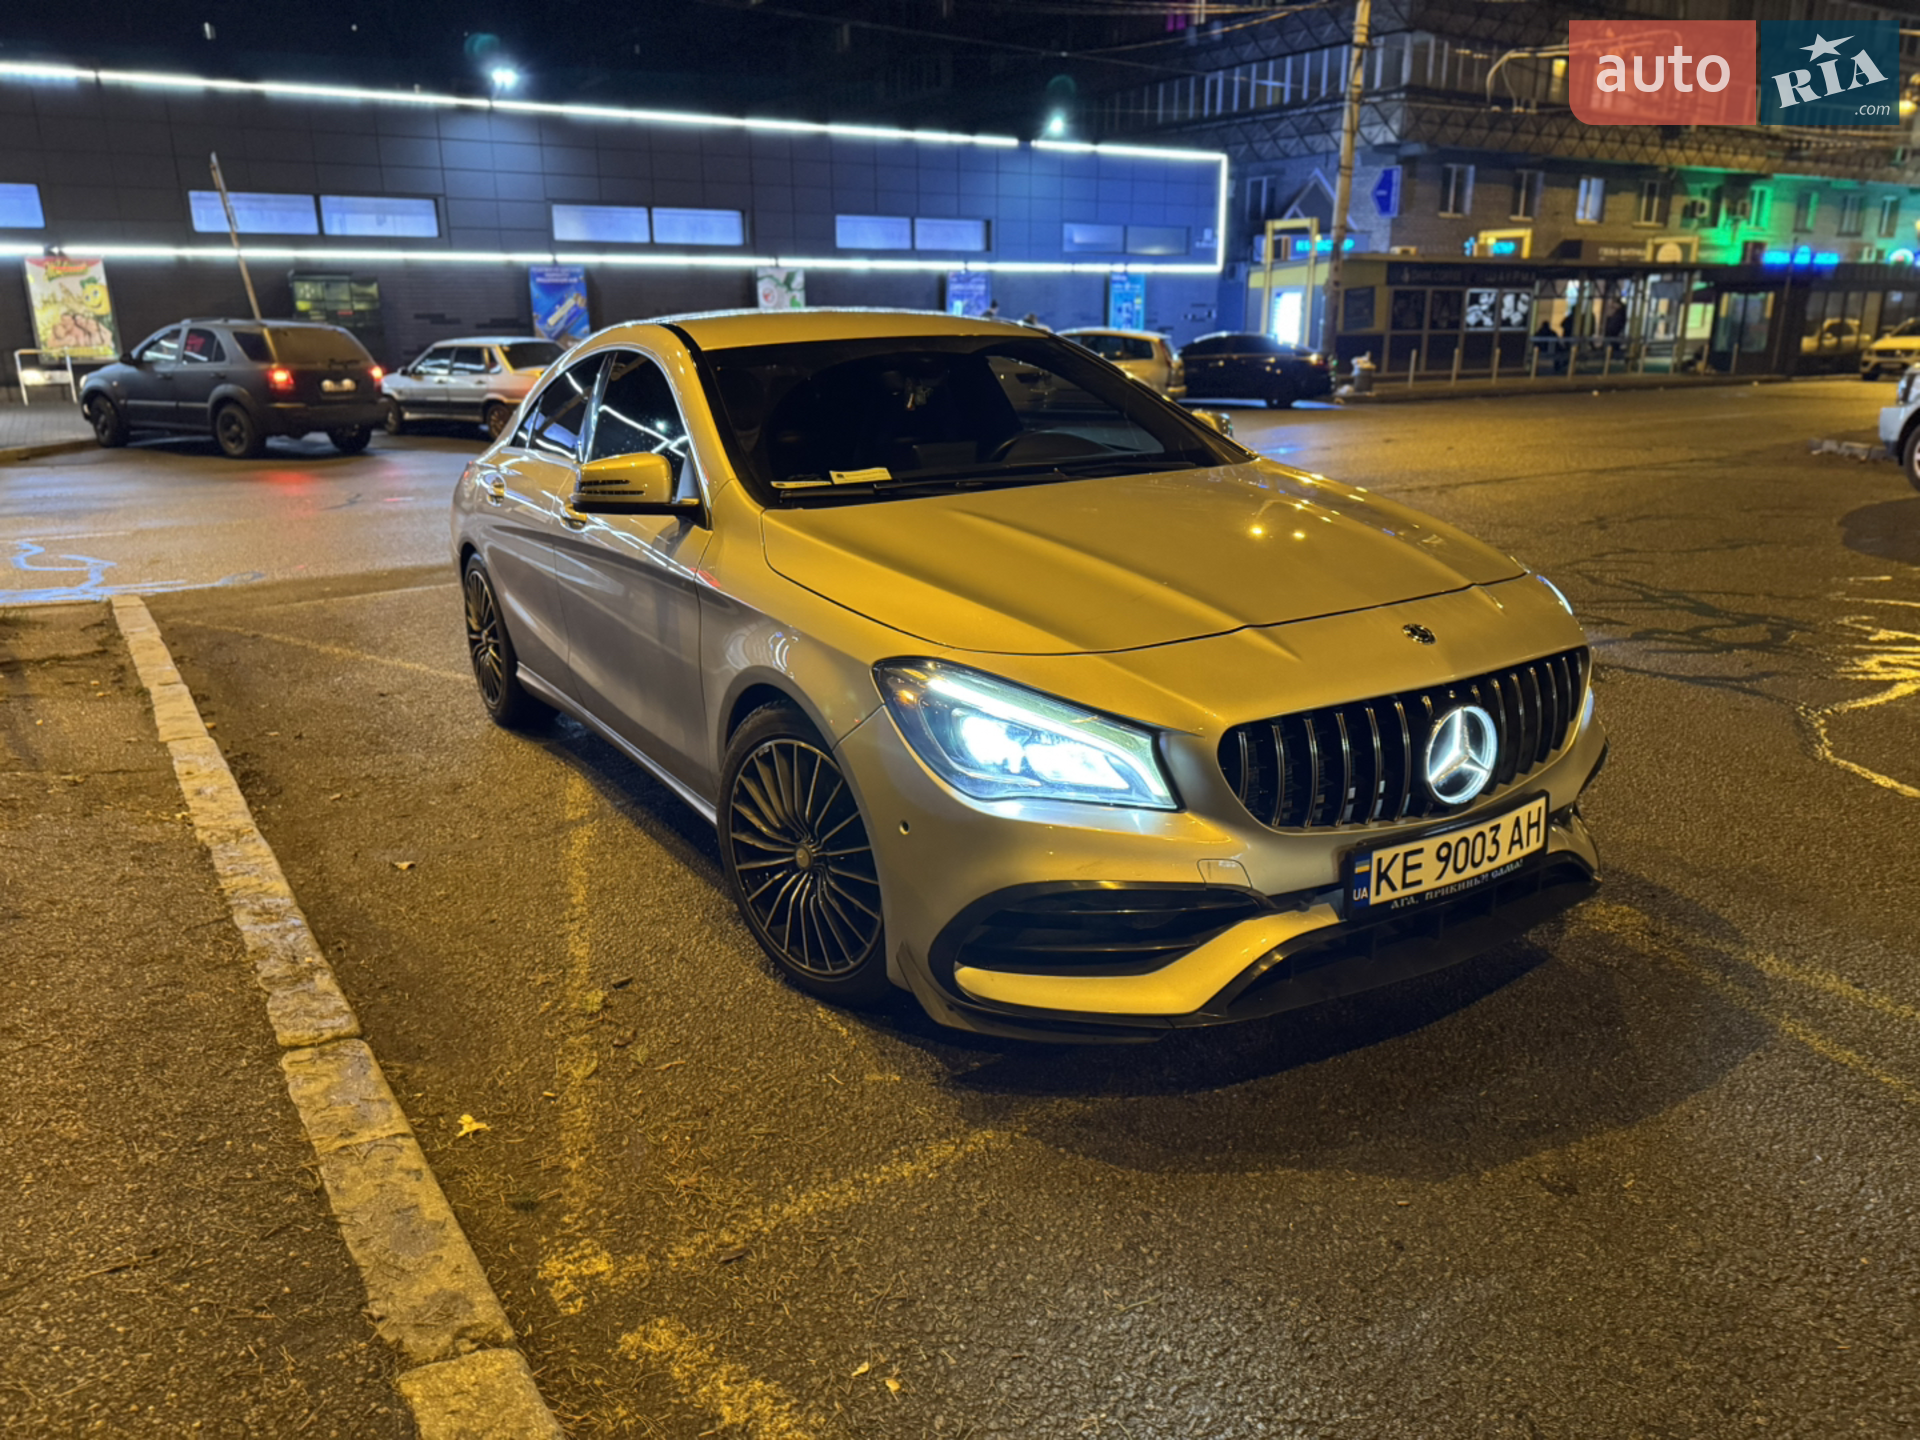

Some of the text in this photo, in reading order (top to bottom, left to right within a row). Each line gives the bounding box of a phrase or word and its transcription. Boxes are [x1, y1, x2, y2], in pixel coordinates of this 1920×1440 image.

[1375, 805, 1542, 897] KE 9003 AH
[1353, 886, 1369, 902] UA
